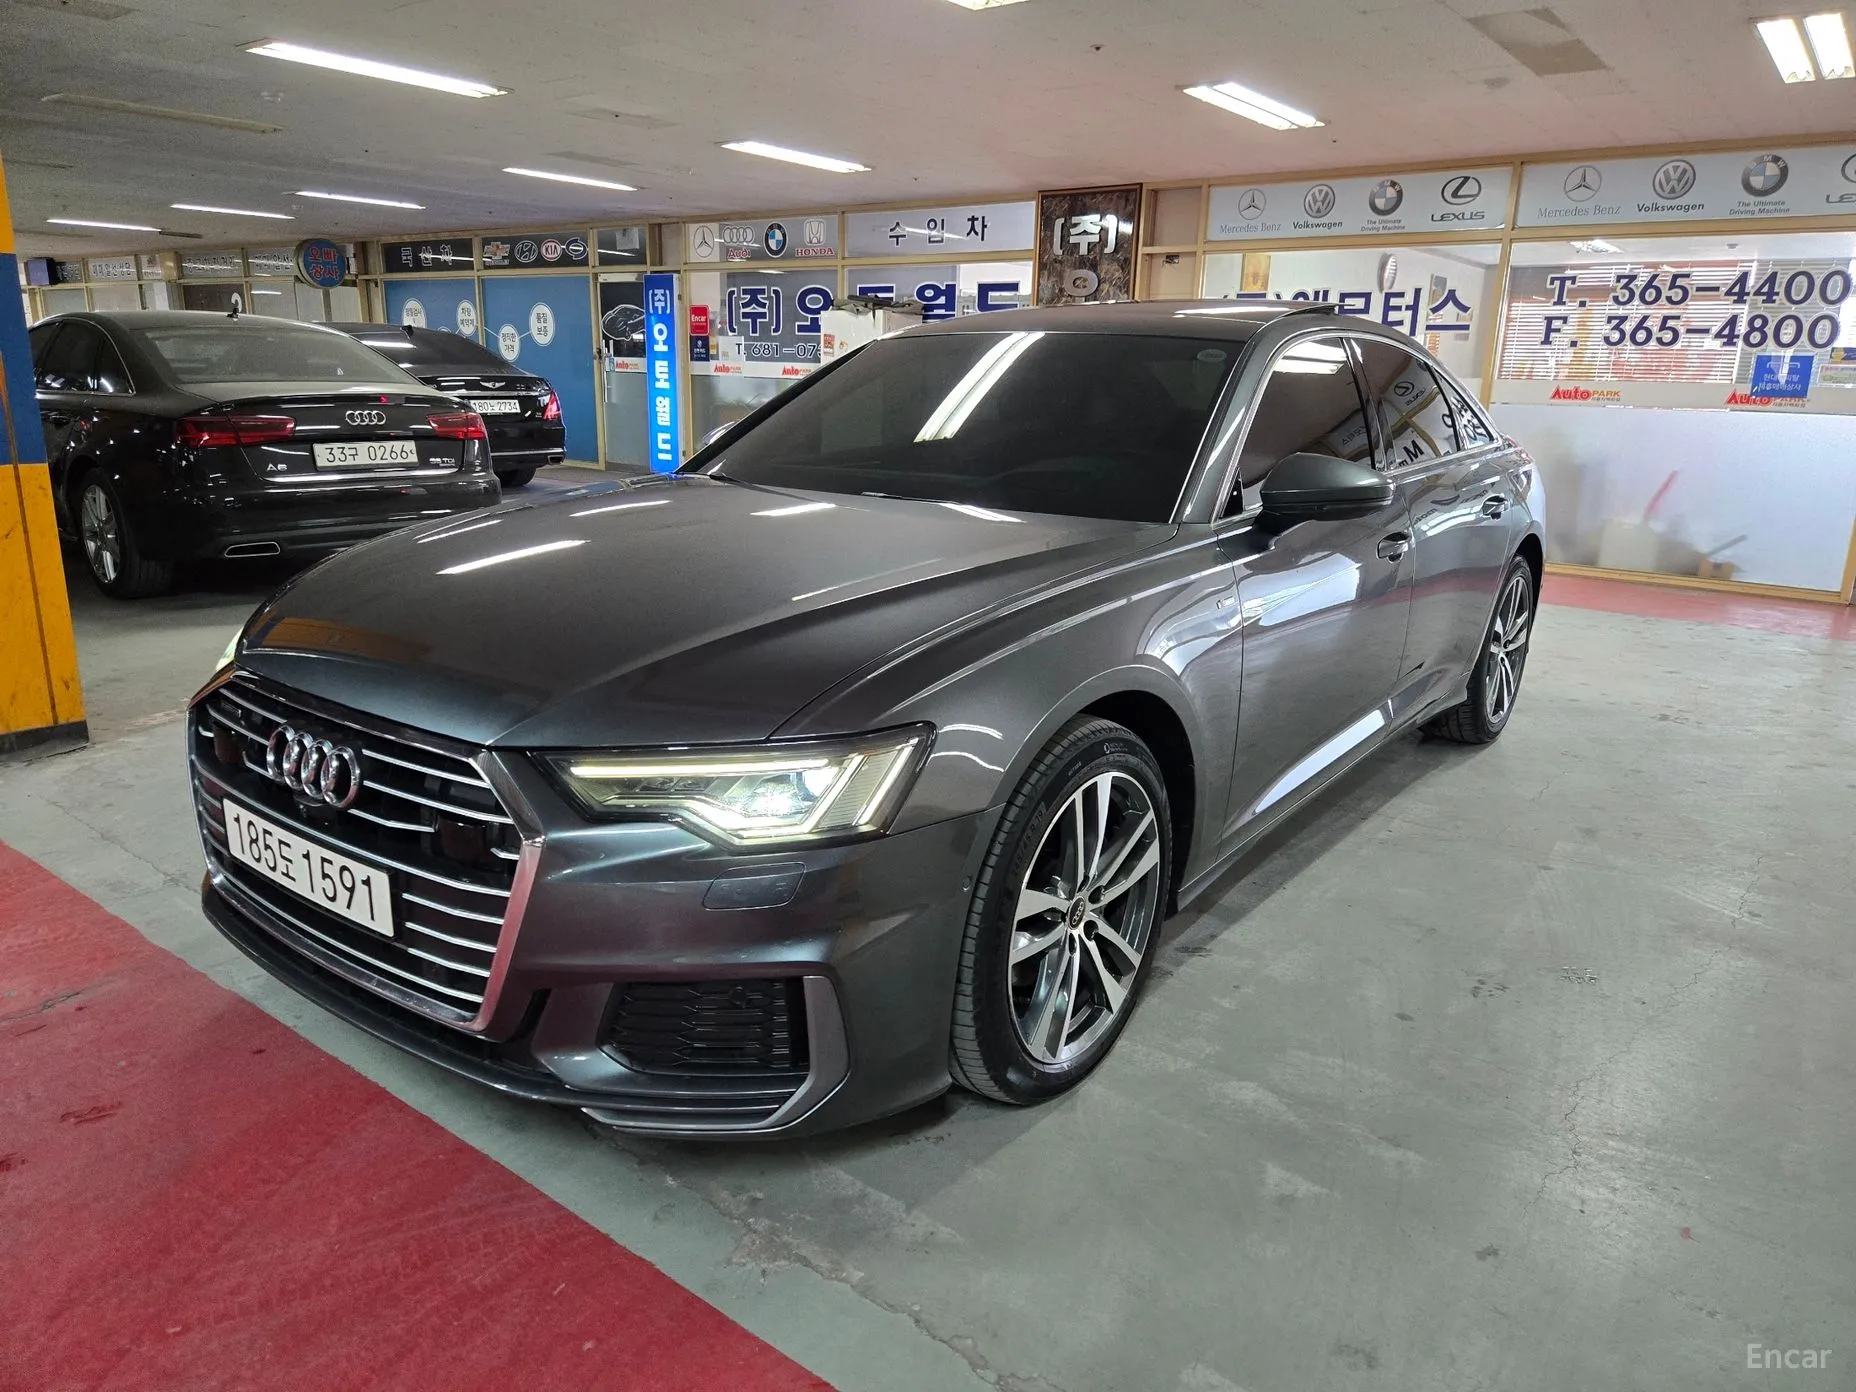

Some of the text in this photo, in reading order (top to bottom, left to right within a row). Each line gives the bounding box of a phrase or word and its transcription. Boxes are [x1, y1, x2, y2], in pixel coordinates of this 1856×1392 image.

[1635, 201, 1705, 214] Volkswagen
[1736, 199, 1786, 208] The Ultimate
[1430, 210, 1485, 223] LEXUS
[1536, 204, 1621, 219] Mercedes Benz
[1728, 206, 1791, 217] Driving Machine
[1218, 222, 1282, 235] Mercedes Benz
[1292, 219, 1343, 231] Volkswagen
[727, 247, 752, 258] Audi
[795, 246, 834, 257] HONDA
[1547, 269, 1852, 309] T. 365-4400
[691, 314, 707, 322] Encar
[1540, 313, 1841, 350] F. 365-4800
[714, 362, 730, 374] Auto
[782, 365, 799, 376] Auto
[1551, 385, 1591, 402] Auto
[497, 400, 519, 412] 2734
[325, 445, 409, 463] 33구 0266
[266, 463, 288, 472] A6
[233, 812, 376, 922] 185도 1591
